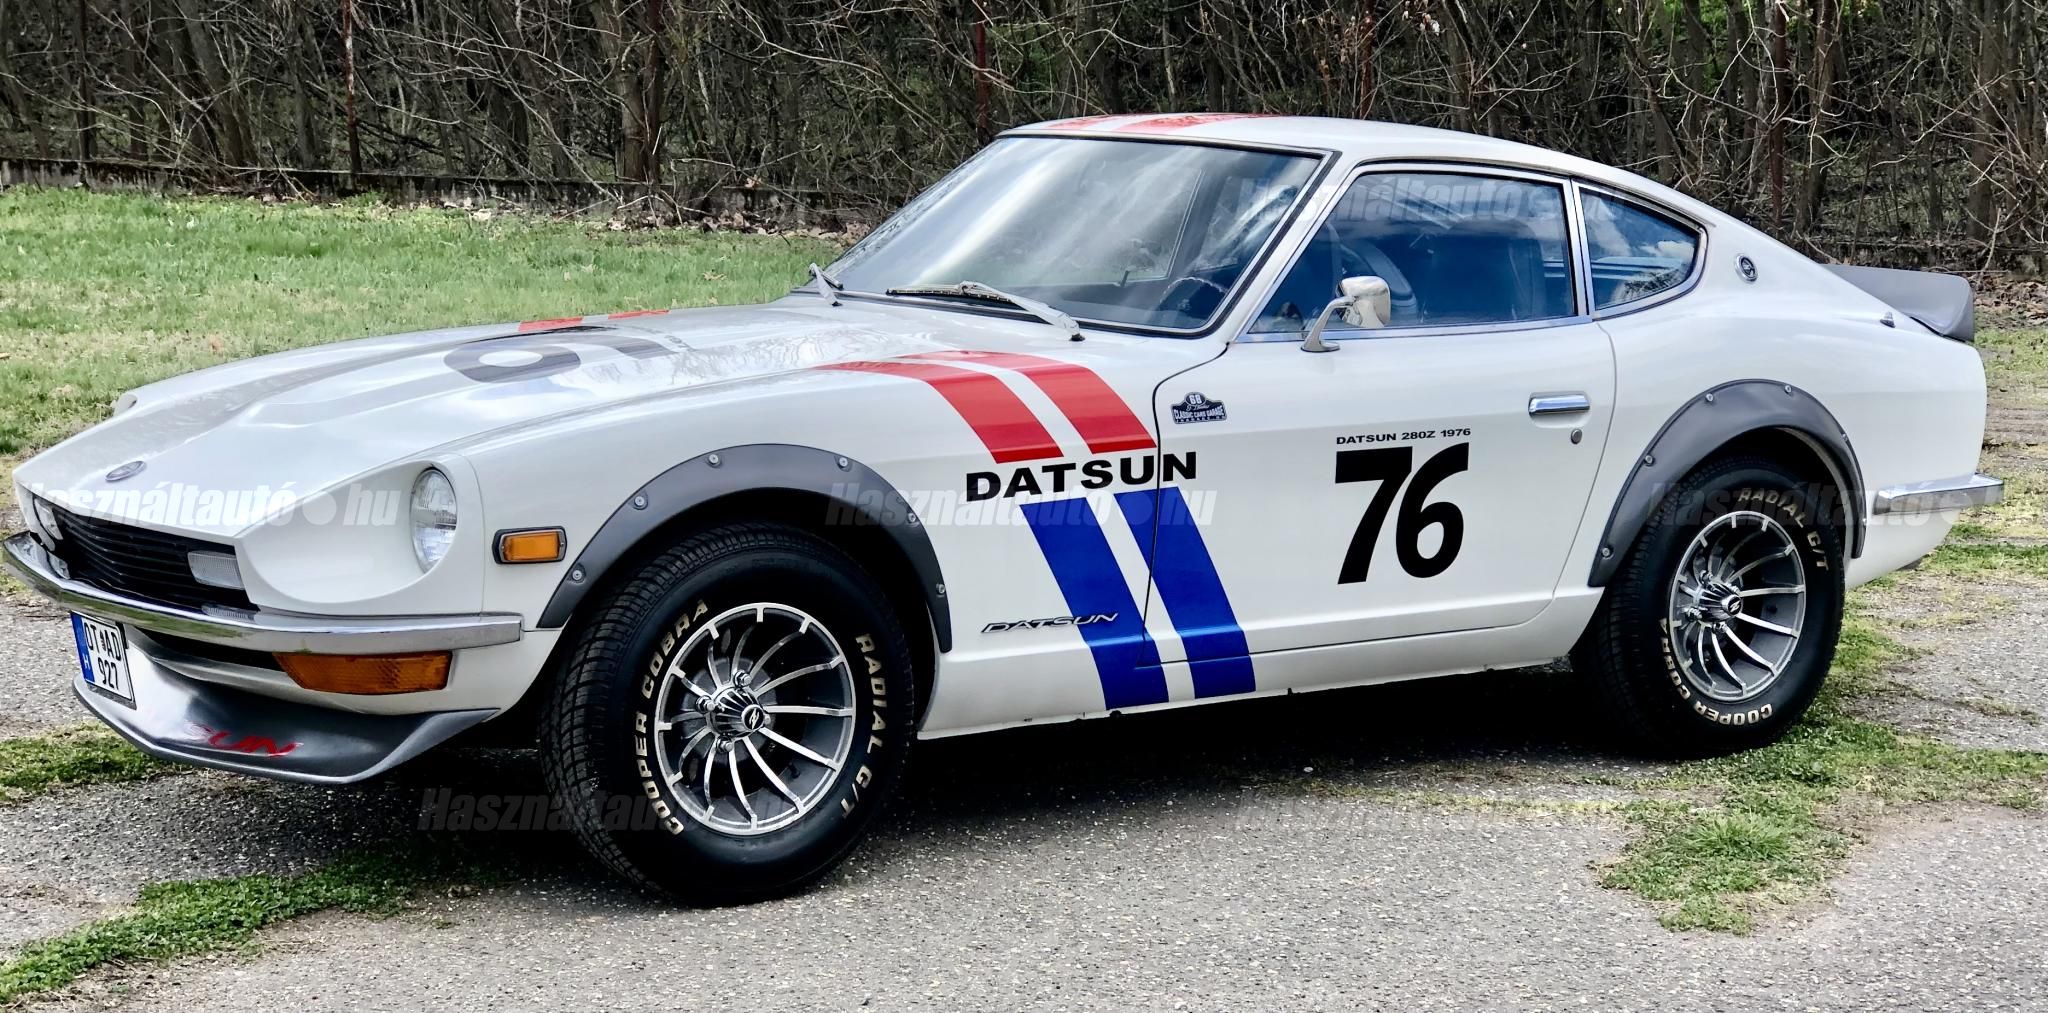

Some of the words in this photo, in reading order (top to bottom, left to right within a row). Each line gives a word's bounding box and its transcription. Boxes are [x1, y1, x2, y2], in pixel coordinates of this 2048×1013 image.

[1336, 433, 1397, 445] DATSUN
[1401, 430, 1436, 440] 280Z
[1440, 428, 1471, 438] 1976
[966, 451, 1197, 502] DATSUN
[1335, 442, 1470, 585] 76
[1738, 488, 1804, 528] RADIAL
[1806, 531, 1829, 571] G/T
[641, 600, 708, 699] COBRA
[979, 612, 1119, 633] DATSUN
[98, 657, 119, 690] 927
[1659, 617, 1691, 700] COBRA
[855, 633, 886, 753] RADIAL
[1694, 701, 1773, 726] COOPER
[635, 711, 684, 835] COOPER
[840, 764, 873, 818] G/T
